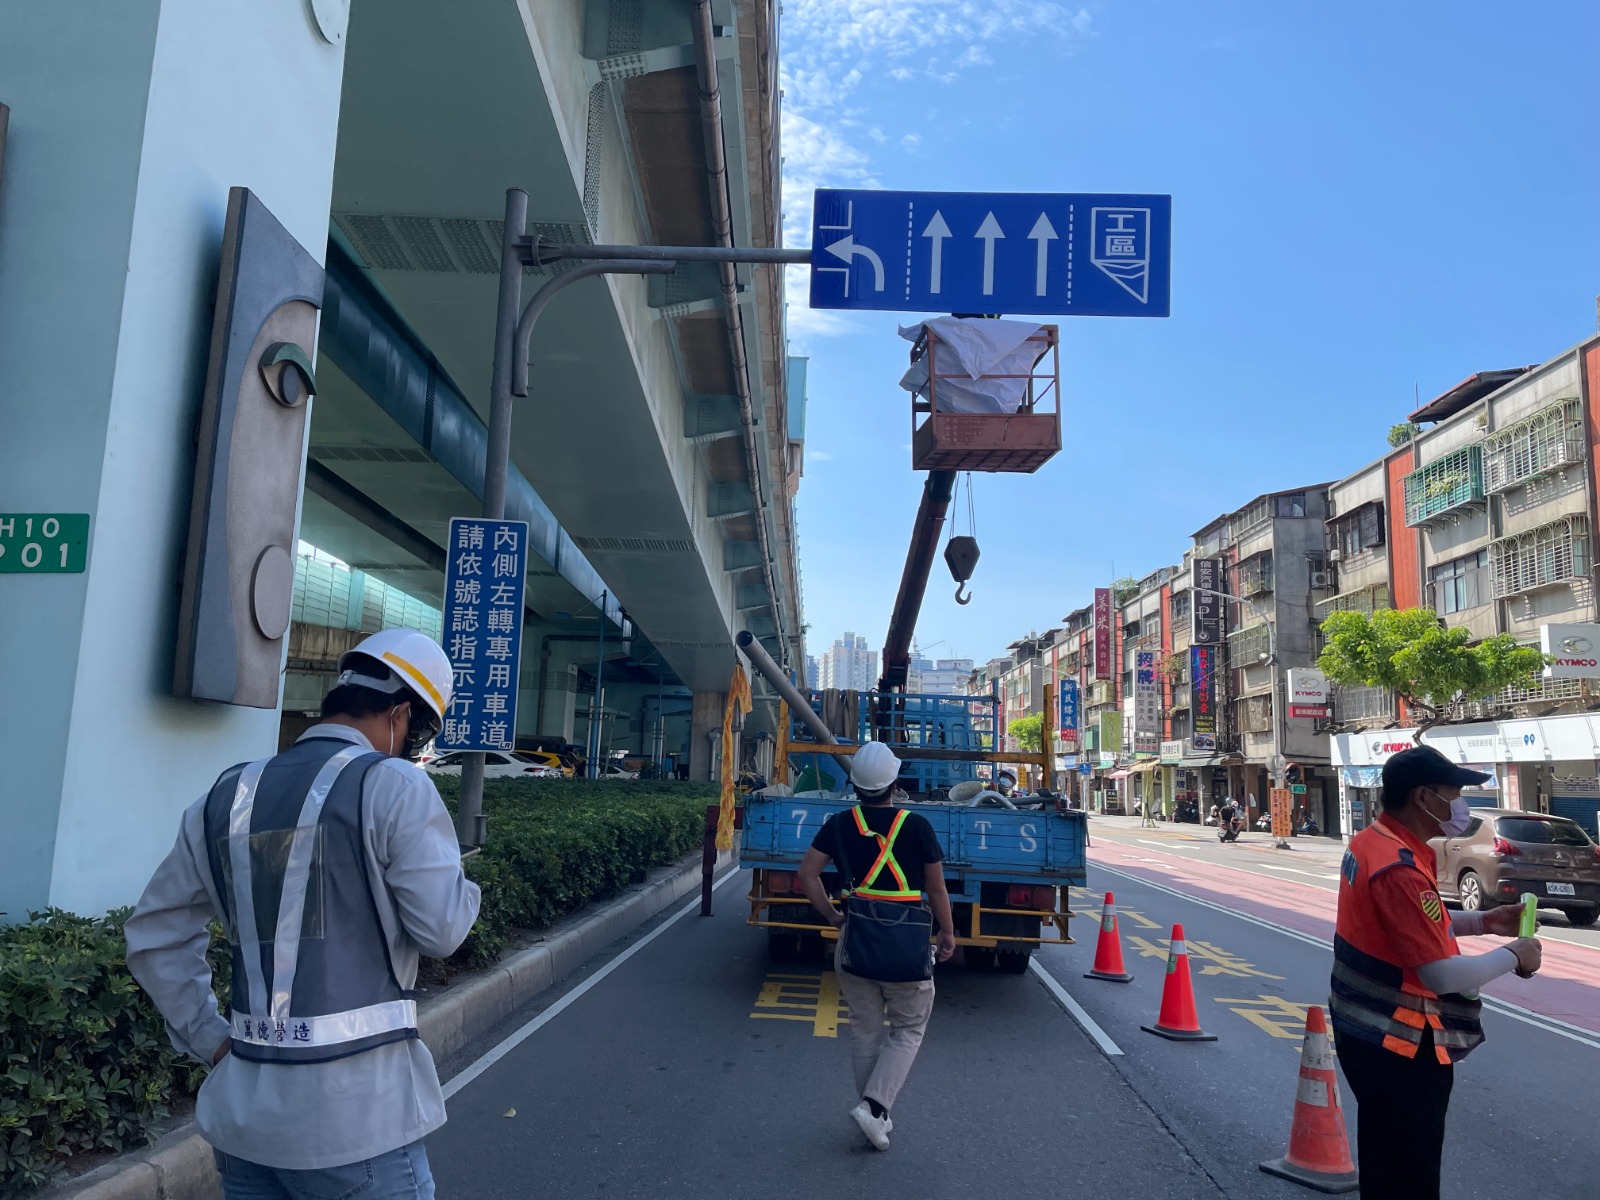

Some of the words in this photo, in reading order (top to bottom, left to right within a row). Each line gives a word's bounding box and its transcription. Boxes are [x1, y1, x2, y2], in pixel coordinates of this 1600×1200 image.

[1106, 214, 1136, 256] 工區
[0, 518, 60, 538] H10
[0, 543, 69, 568] 01
[444, 524, 485, 746] 請依號誌指示行駛
[480, 526, 518, 746] 內側左轉專用車道
[1137, 652, 1154, 685] 招牌
[1555, 658, 1598, 667] KYMCO
[243, 1019, 311, 1042] 萬德營造
